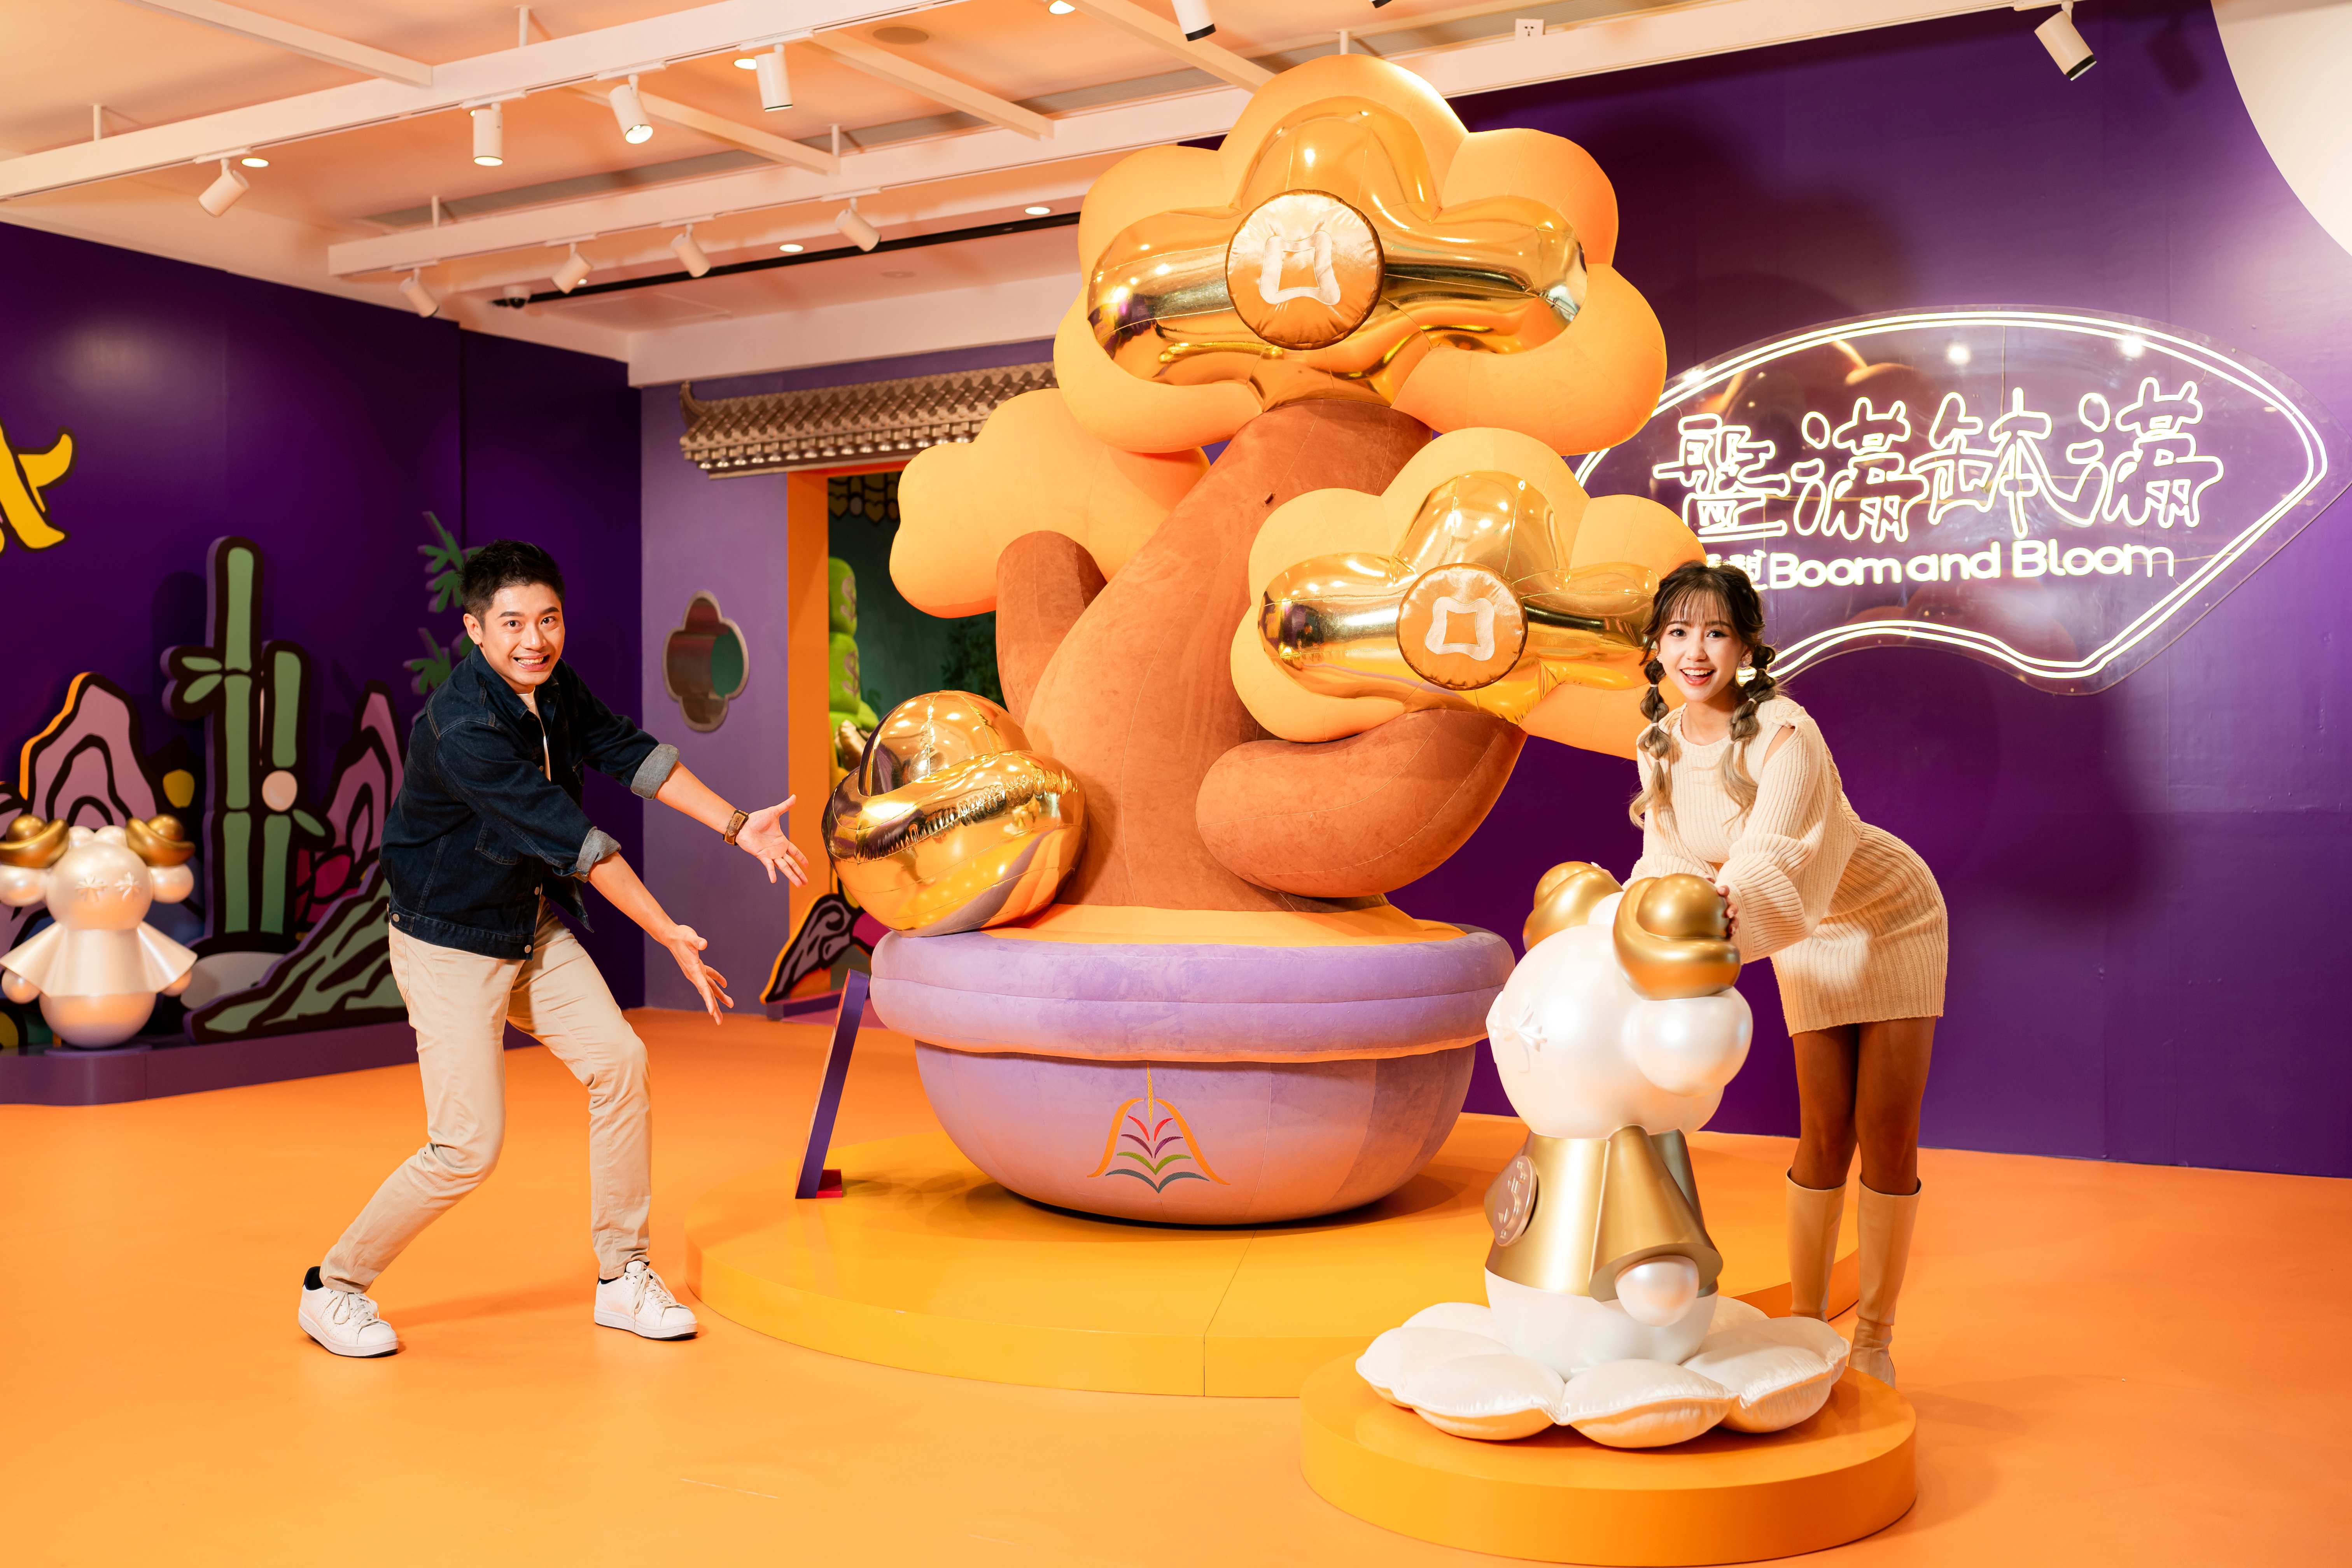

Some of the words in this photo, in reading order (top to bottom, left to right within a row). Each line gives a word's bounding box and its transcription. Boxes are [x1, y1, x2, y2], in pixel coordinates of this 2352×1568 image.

[1769, 552, 1902, 590] Boom
[1905, 541, 2002, 582] and
[2011, 538, 2175, 578] Bloom
